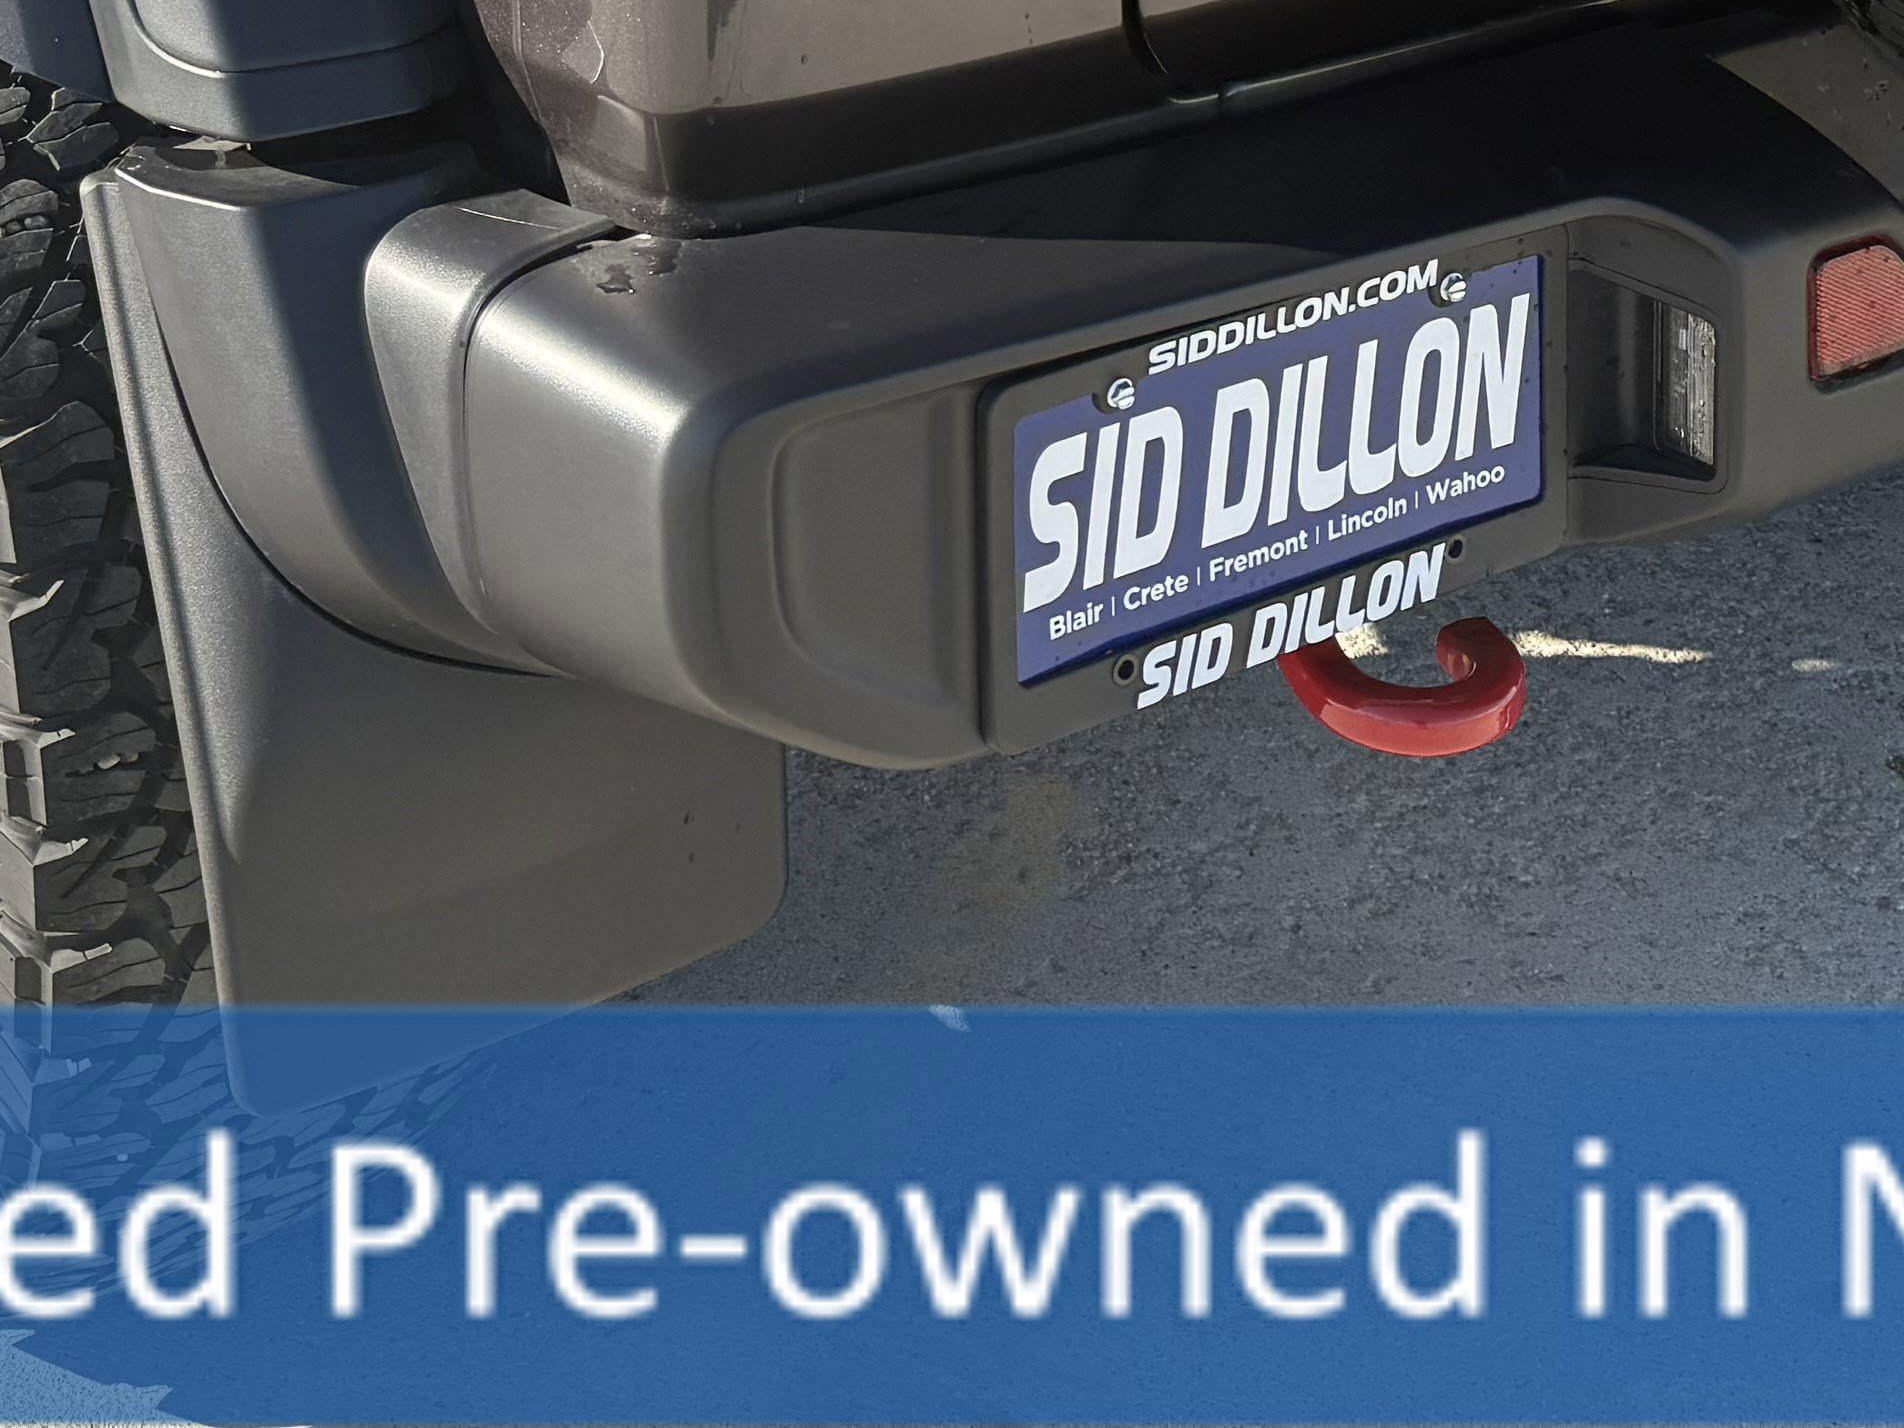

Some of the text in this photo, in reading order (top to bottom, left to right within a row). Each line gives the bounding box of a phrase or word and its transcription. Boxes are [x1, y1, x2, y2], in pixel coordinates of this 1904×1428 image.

[1148, 258, 1439, 376] SIDDILLON.COM
[1022, 294, 1531, 613] SID DILLON
[1049, 460, 1506, 640] Blair Crete Fremont Lincoln Wahoo
[1137, 541, 1447, 709] SID DILLON
